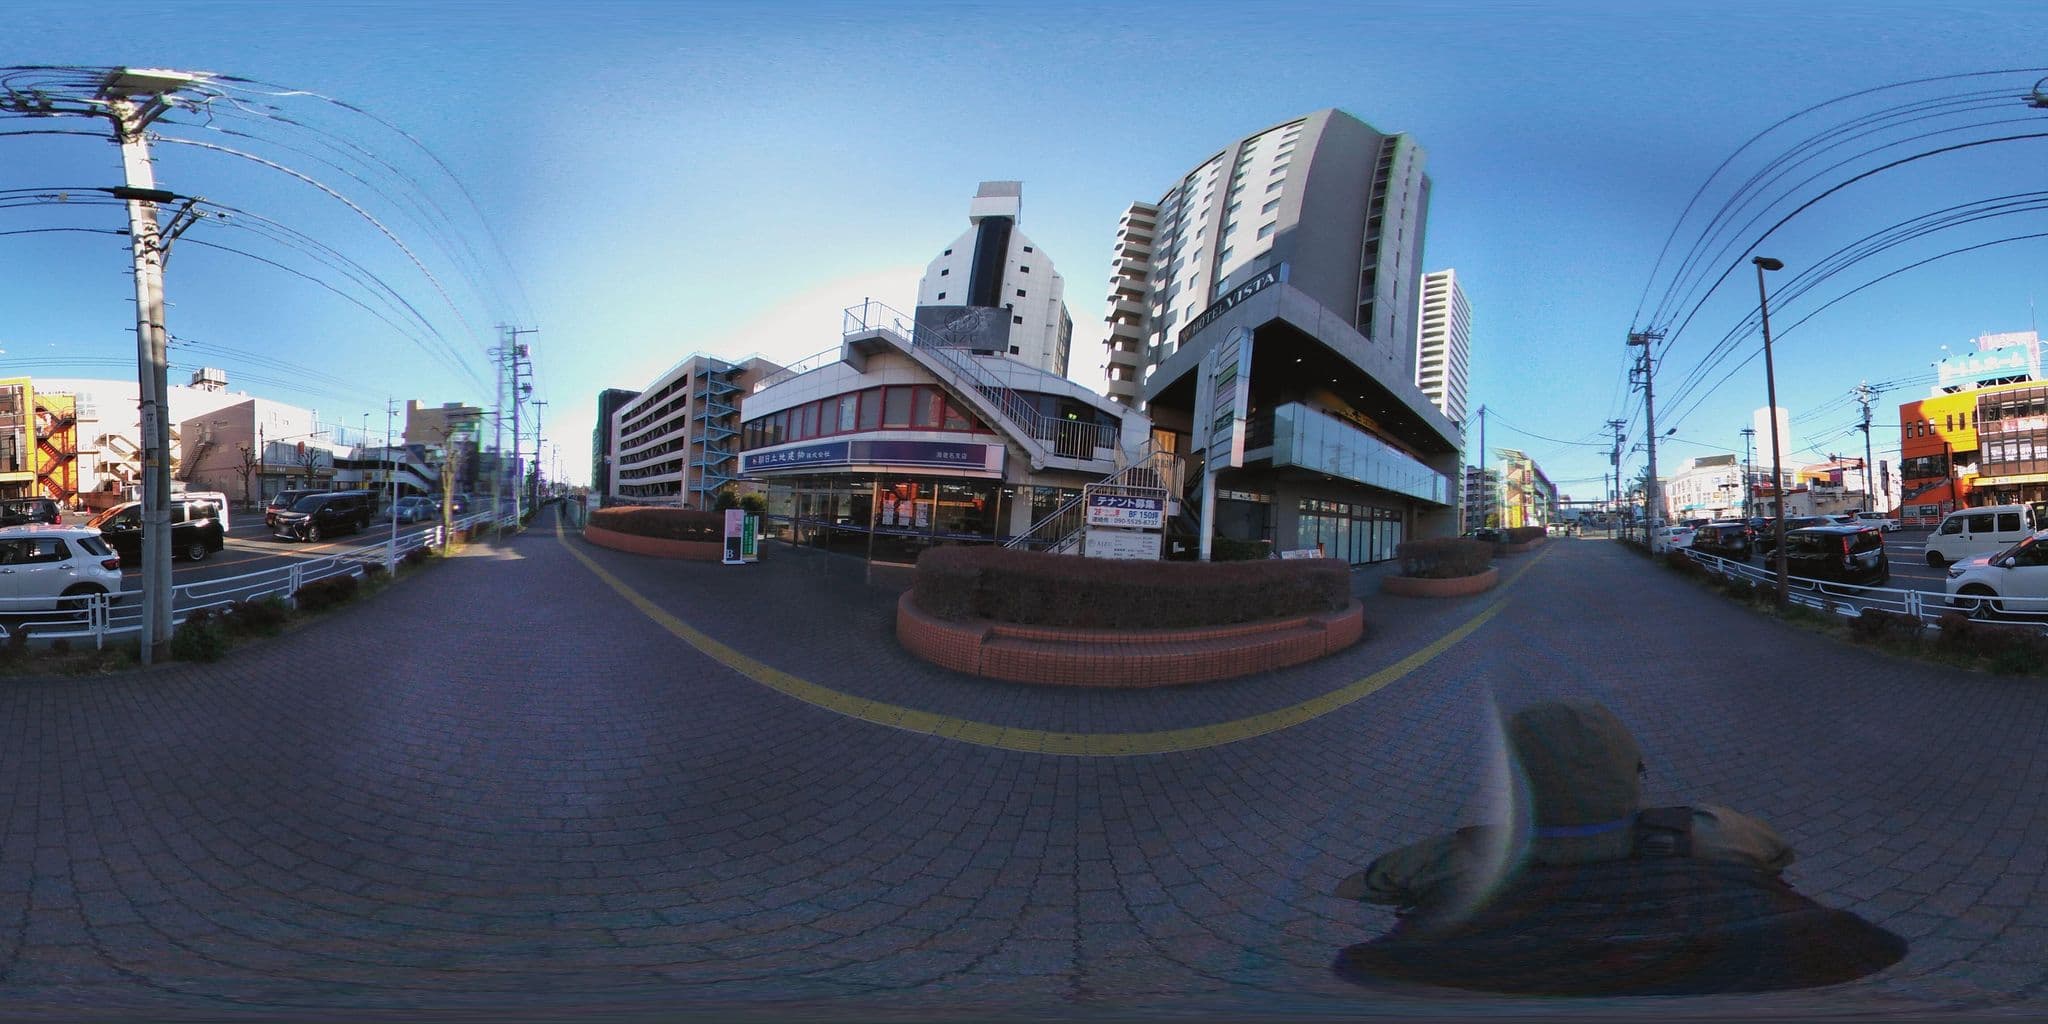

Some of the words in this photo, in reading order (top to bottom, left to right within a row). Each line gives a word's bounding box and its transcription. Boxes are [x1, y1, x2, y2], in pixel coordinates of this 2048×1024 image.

[1193, 304, 1225, 334] HOTEL
[1226, 273, 1275, 308] VISTA
[1097, 496, 1155, 509] テナント募集
